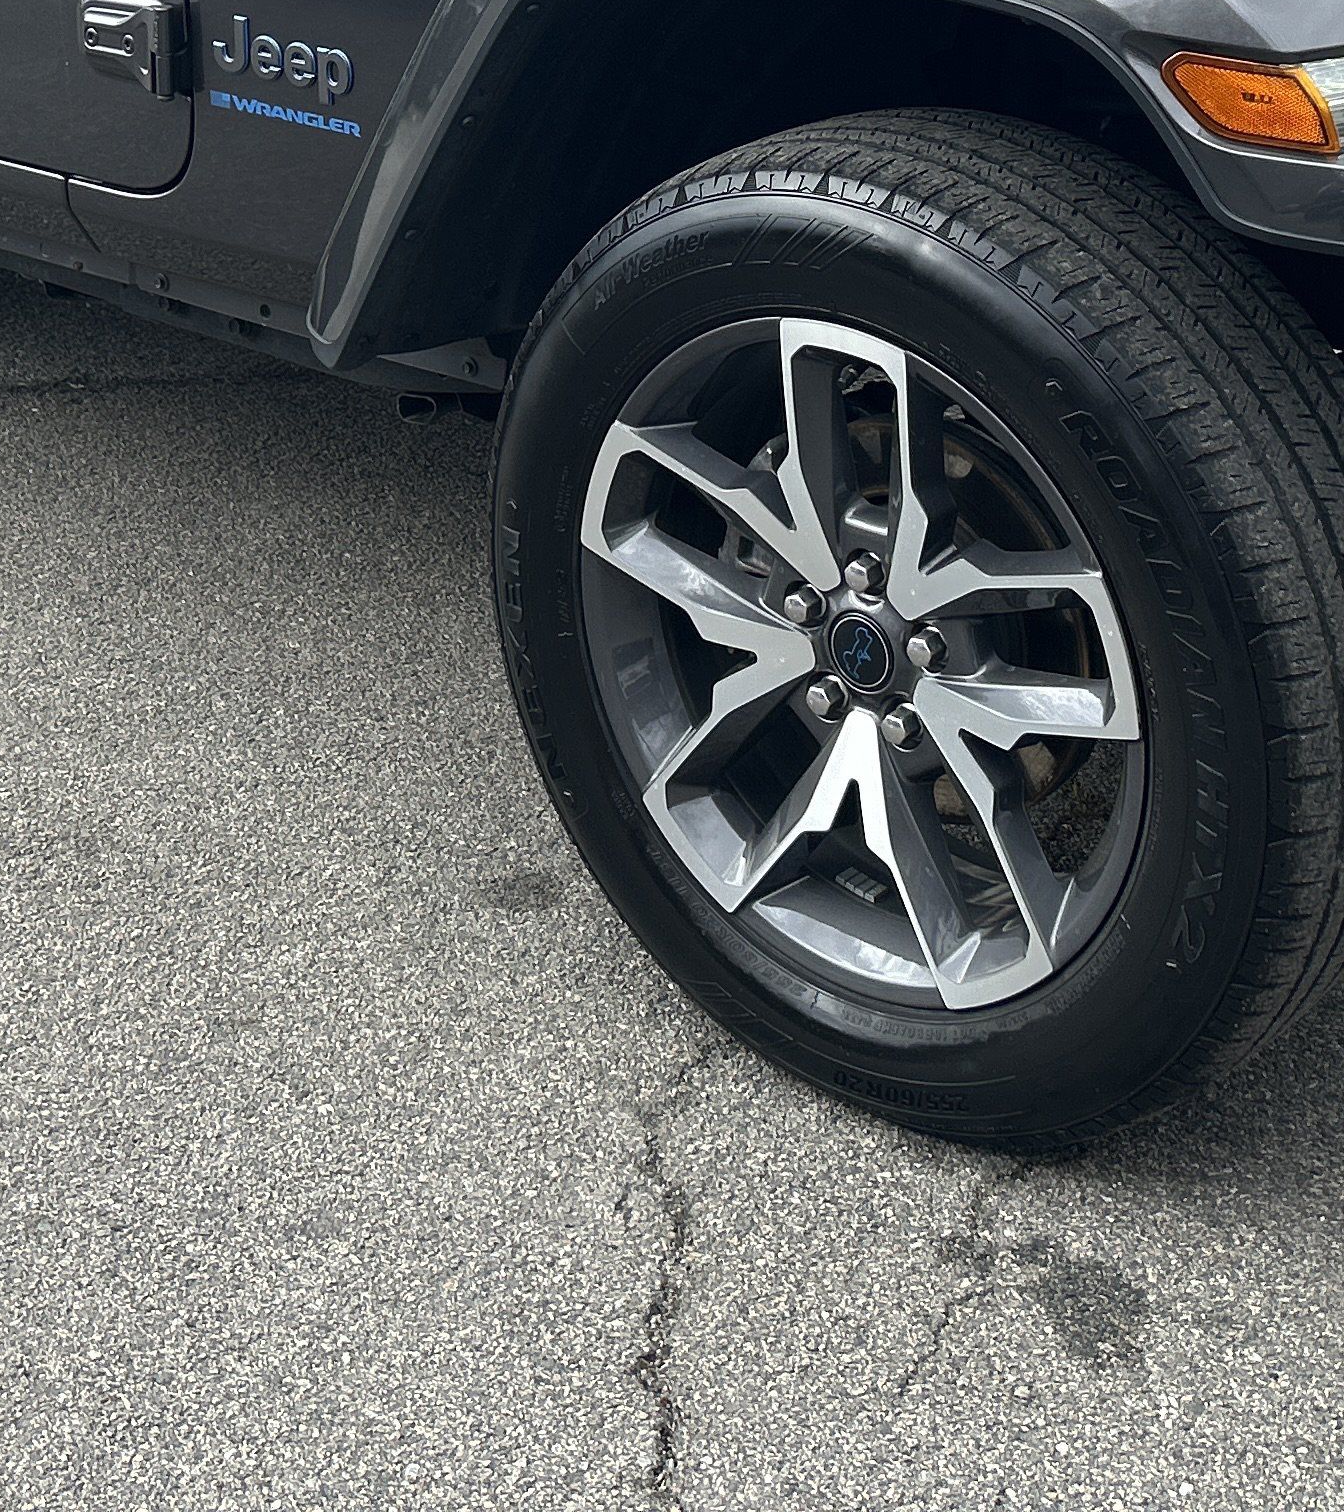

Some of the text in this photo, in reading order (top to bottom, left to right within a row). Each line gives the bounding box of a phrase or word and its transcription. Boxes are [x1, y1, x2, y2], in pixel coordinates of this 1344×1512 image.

[212, 14, 355, 106] Jeep
[230, 94, 362, 138] WRANGLER
[593, 231, 710, 311] All-Weather
[1059, 410, 1228, 750] ROADIAN
[502, 524, 567, 780] NEXEN
[832, 1070, 971, 1113] 255/60R20
